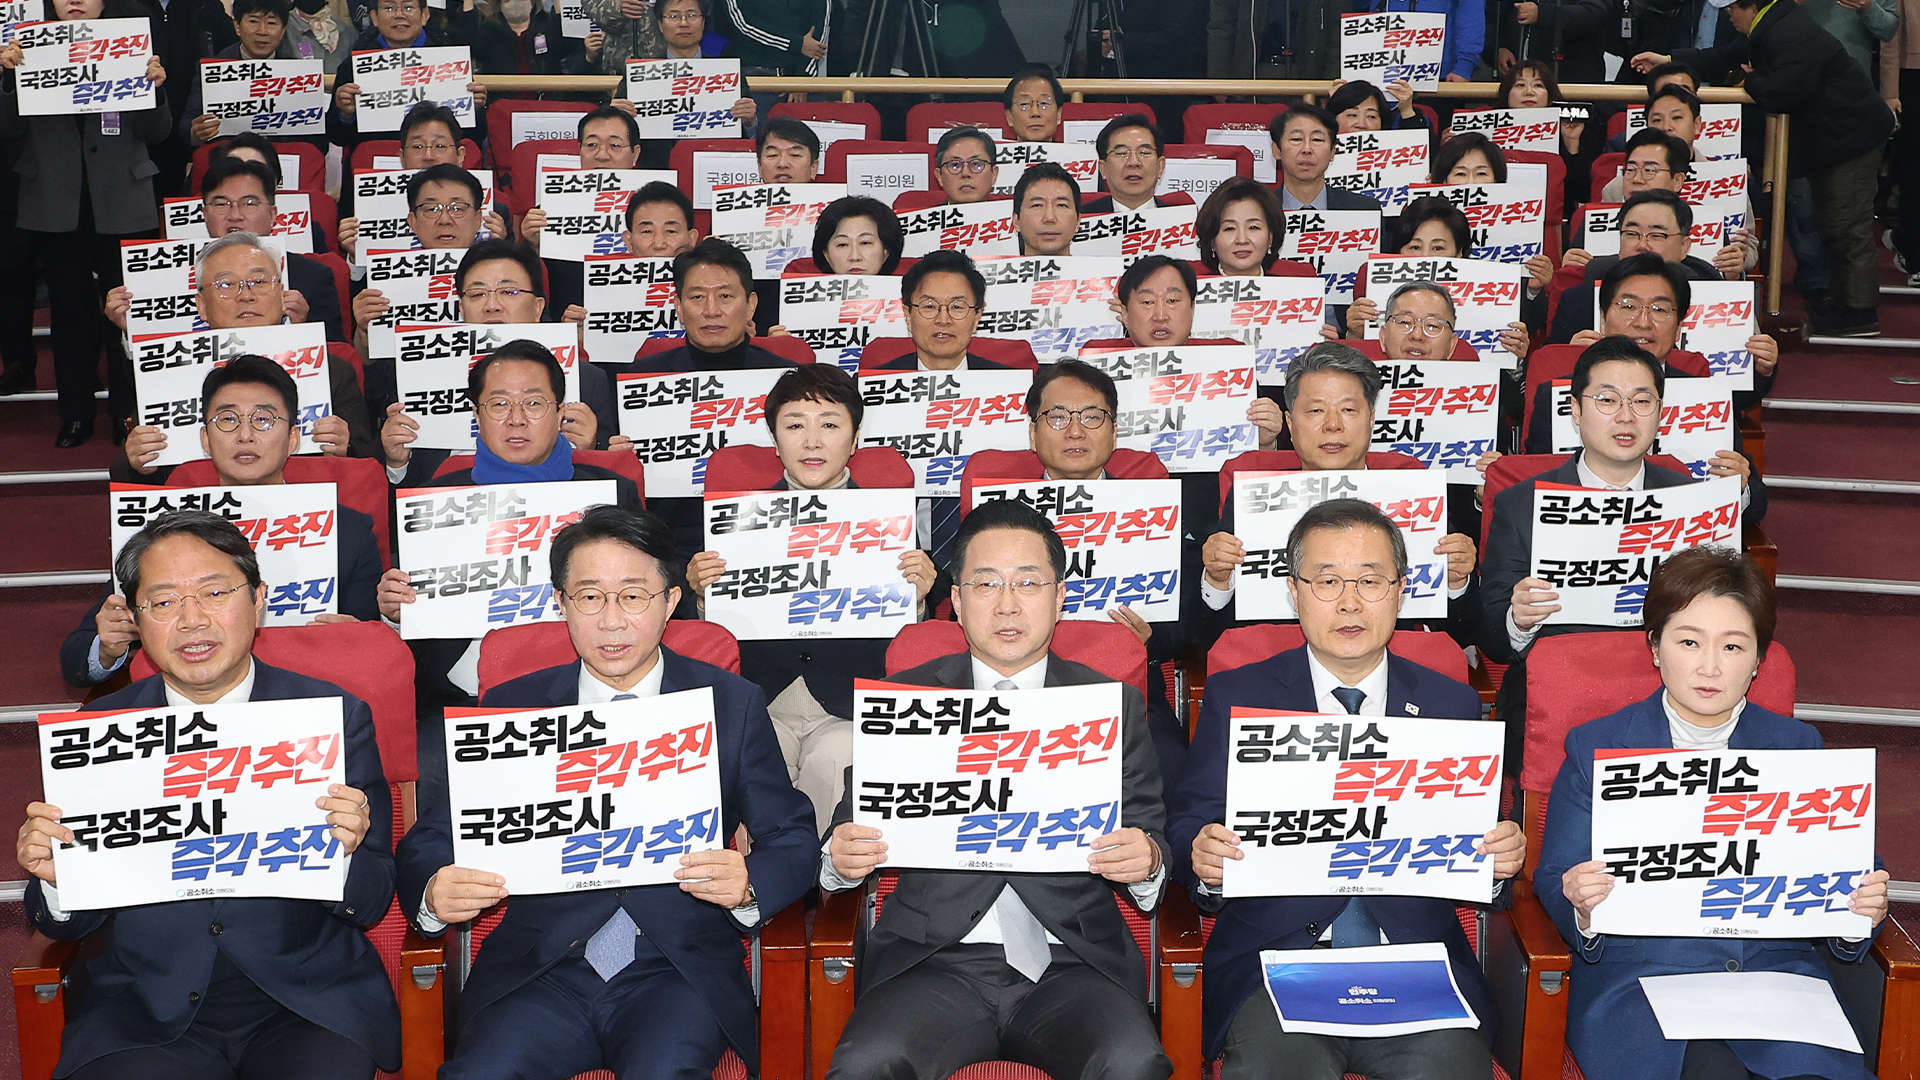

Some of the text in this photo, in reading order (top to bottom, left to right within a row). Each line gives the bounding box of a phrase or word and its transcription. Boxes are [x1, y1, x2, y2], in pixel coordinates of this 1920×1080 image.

[19, 22, 94, 49] 공소취소
[1344, 16, 1405, 35] 공소취소
[1384, 27, 1444, 48] 즉각 추진
[68, 33, 149, 64] 즉각 추진
[1344, 50, 1406, 70] 국정조사
[20, 63, 99, 90] 국정조사
[205, 62, 273, 83] 공소취소
[356, 54, 422, 74] 공소취소
[400, 61, 470, 86] 즉각 추진
[630, 61, 694, 82] 공소취소
[1384, 62, 1440, 83] 즉각 추진
[72, 75, 151, 106] 즉각 추진
[250, 73, 322, 98] 즉각 추진
[359, 88, 426, 109] 국정조사
[671, 71, 741, 96] 즉각 추진
[206, 99, 276, 120] 국정조사
[251, 106, 323, 130] 즉각 추진
[634, 99, 696, 120] 국정조사
[672, 106, 738, 132] 즉각 추진
[1453, 113, 1514, 132] 공소취소
[1560, 107, 1589, 119] 소취소
[1493, 120, 1558, 144] 즉각 추진
[1705, 118, 1741, 141] 추진
[1064, 158, 1098, 181] 추진
[1357, 144, 1428, 170] 즉각 추진
[544, 173, 621, 195] 공소취소
[706, 171, 761, 186] 국회의원
[859, 174, 915, 189] 국회의원
[1167, 178, 1222, 193] 국회의원
[1680, 174, 1746, 201] 즉각 추진
[716, 187, 791, 211] 공소취소
[1464, 199, 1542, 226] 즉각 추진
[545, 215, 621, 236] 국정조사
[765, 205, 805, 227] 즉각
[940, 217, 1015, 249] 즉각 추진
[1121, 221, 1198, 257] 즉각 추진
[1296, 228, 1379, 254] 즉각 추진
[371, 254, 459, 280] 공소취소
[765, 247, 807, 271] 즉각
[1502, 242, 1541, 263] 추진
[589, 262, 675, 287] 공소취소
[980, 258, 1061, 285] 공소취소
[1371, 261, 1458, 283] 공소취소
[784, 280, 869, 304] 공소취소
[1031, 276, 1119, 306] 즉각 추진
[1473, 281, 1519, 307] 추진
[373, 301, 459, 327] 국정조사
[588, 309, 677, 333] 국정조사
[839, 300, 887, 325] 즉각
[977, 307, 1063, 333] 국정조사
[1230, 296, 1322, 326] 즉각 추진
[1703, 301, 1751, 328] 추진
[139, 332, 246, 373] 공소취소
[400, 328, 501, 361] 공소취소
[1031, 324, 1120, 354] 즉각 추진
[1708, 349, 1751, 377] 추진
[623, 374, 723, 410] 공소취소
[863, 374, 960, 406] 공소취소
[1148, 367, 1254, 404] 즉각 추진
[1388, 383, 1498, 416] 즉각 추진
[690, 396, 743, 429] 즉각
[925, 392, 1027, 430] 즉각 추진
[1678, 400, 1730, 433] 추진
[634, 431, 727, 464] 국정조사
[1151, 424, 1255, 460] 즉각 추진
[1391, 441, 1441, 469] 즉각
[404, 489, 526, 533] 공소취소
[710, 494, 828, 535] 공소취소
[1394, 497, 1444, 532] 추진
[1539, 495, 1663, 525] 공소취소
[267, 510, 334, 551] 추진
[485, 514, 552, 555] 즉각
[787, 514, 913, 559] 즉각 추진
[1055, 506, 1178, 548] 즉각 추진
[1617, 501, 1739, 555] 즉각 추진
[408, 556, 531, 599] 국정조사
[714, 560, 831, 600] 국정조사
[1536, 556, 1660, 588] 국정조사
[268, 577, 335, 616] 추진
[487, 583, 553, 624] 즉각
[788, 582, 911, 626] 즉각 추진
[1062, 570, 1178, 612] 즉각 추진
[860, 697, 1011, 735] 공소취소
[50, 711, 218, 770] 공소취소
[454, 711, 606, 762] 공소취소
[956, 716, 1119, 776] 즉각 추진
[1236, 723, 1389, 763] 공소취소
[163, 732, 340, 799] 즉각 추진
[556, 721, 712, 794] 즉각 추진
[1333, 754, 1500, 803] 즉각 추진
[1601, 757, 1760, 801] 공소취소
[859, 778, 1013, 820] 국정조사
[1702, 783, 1872, 836] 즉각 추진
[60, 799, 227, 853] 국정조사
[460, 793, 615, 846] 국정조사
[956, 801, 1119, 855] 즉각 추진
[1233, 805, 1388, 848] 국정조사
[172, 823, 339, 882] 즉각 추진
[562, 806, 719, 875] 즉각 추진
[968, 860, 994, 868] 공소취소
[1328, 834, 1487, 879] 즉각 추진
[1602, 840, 1760, 884] 국정조사
[186, 888, 215, 897] 공소취소
[575, 880, 602, 889] 공소취소
[1339, 885, 1365, 893] 공소취소
[1700, 870, 1870, 919] 즉각 추진
[1712, 927, 1739, 935] 공소취소
